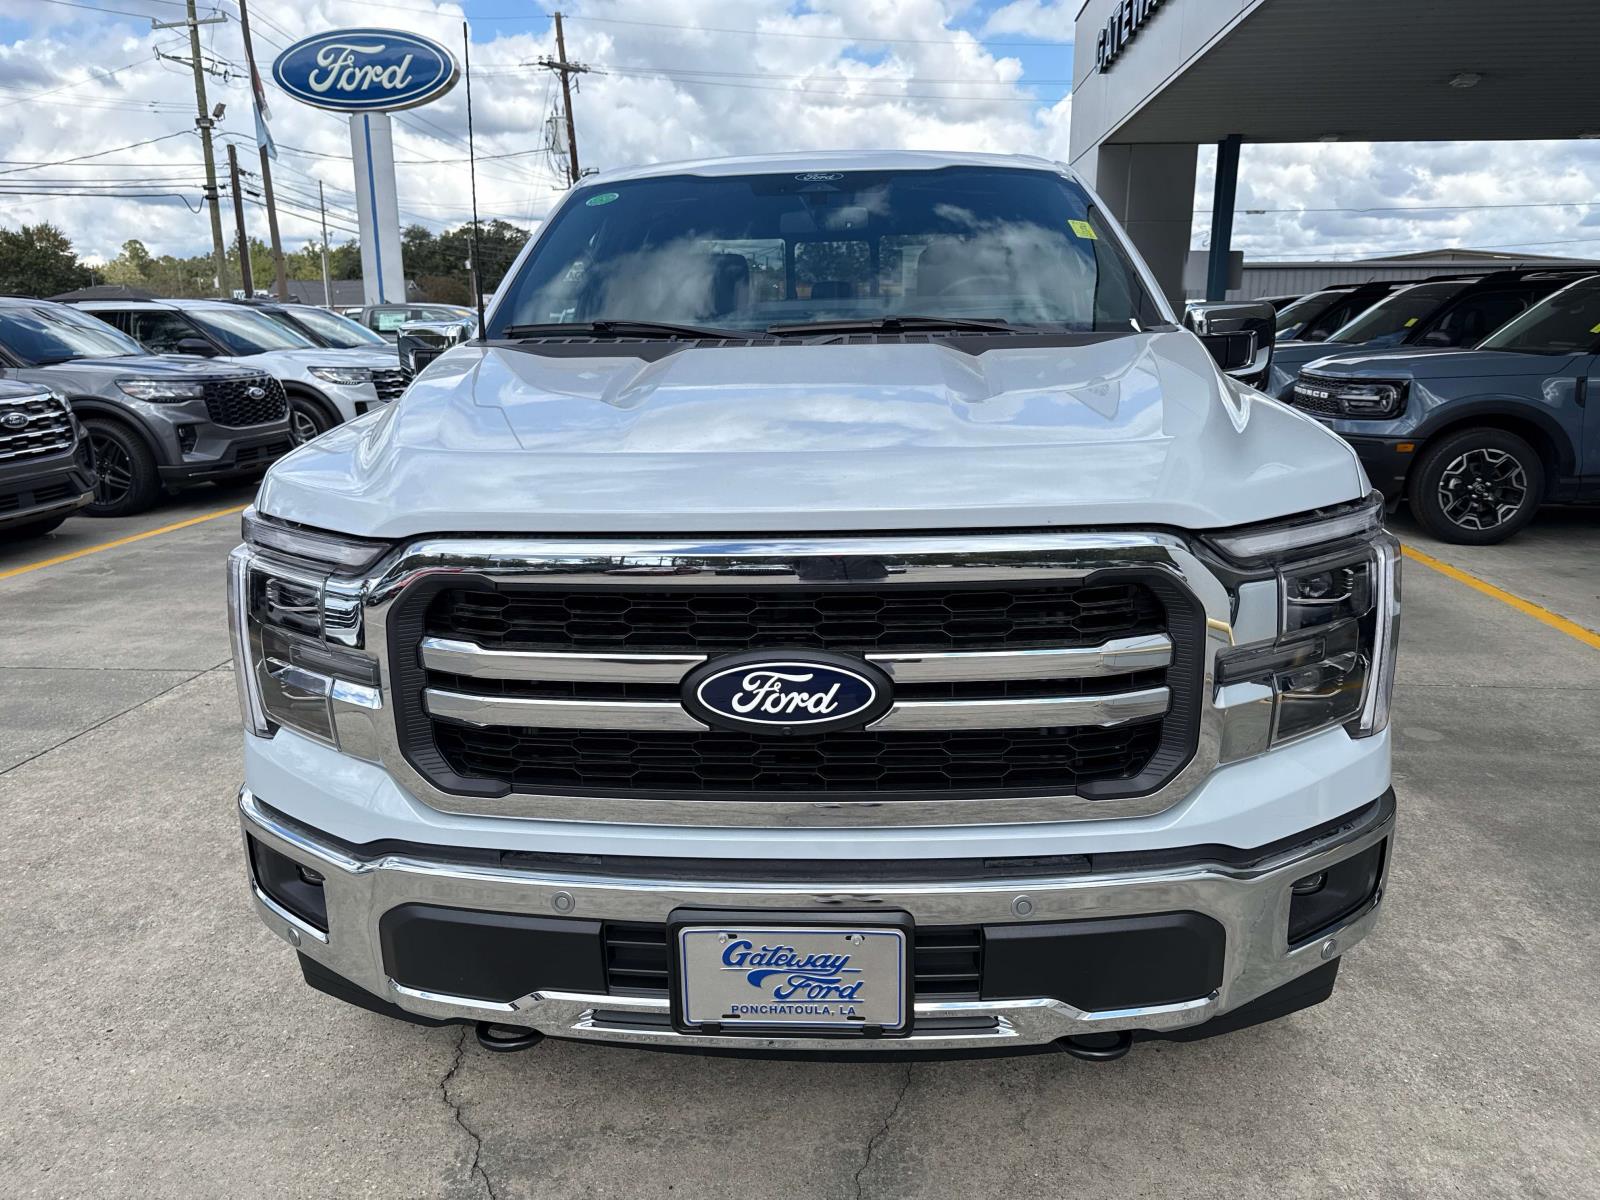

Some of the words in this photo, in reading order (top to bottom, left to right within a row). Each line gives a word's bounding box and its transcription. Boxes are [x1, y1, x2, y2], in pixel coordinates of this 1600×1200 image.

[309, 44, 414, 92] Ford
[803, 173, 836, 181] Ford
[731, 671, 842, 714] Ford
[721, 940, 851, 977] Gateway
[773, 973, 864, 1000] Ford
[731, 1005, 835, 1016] PONCHATOULA,
[839, 1006, 856, 1016] LA
